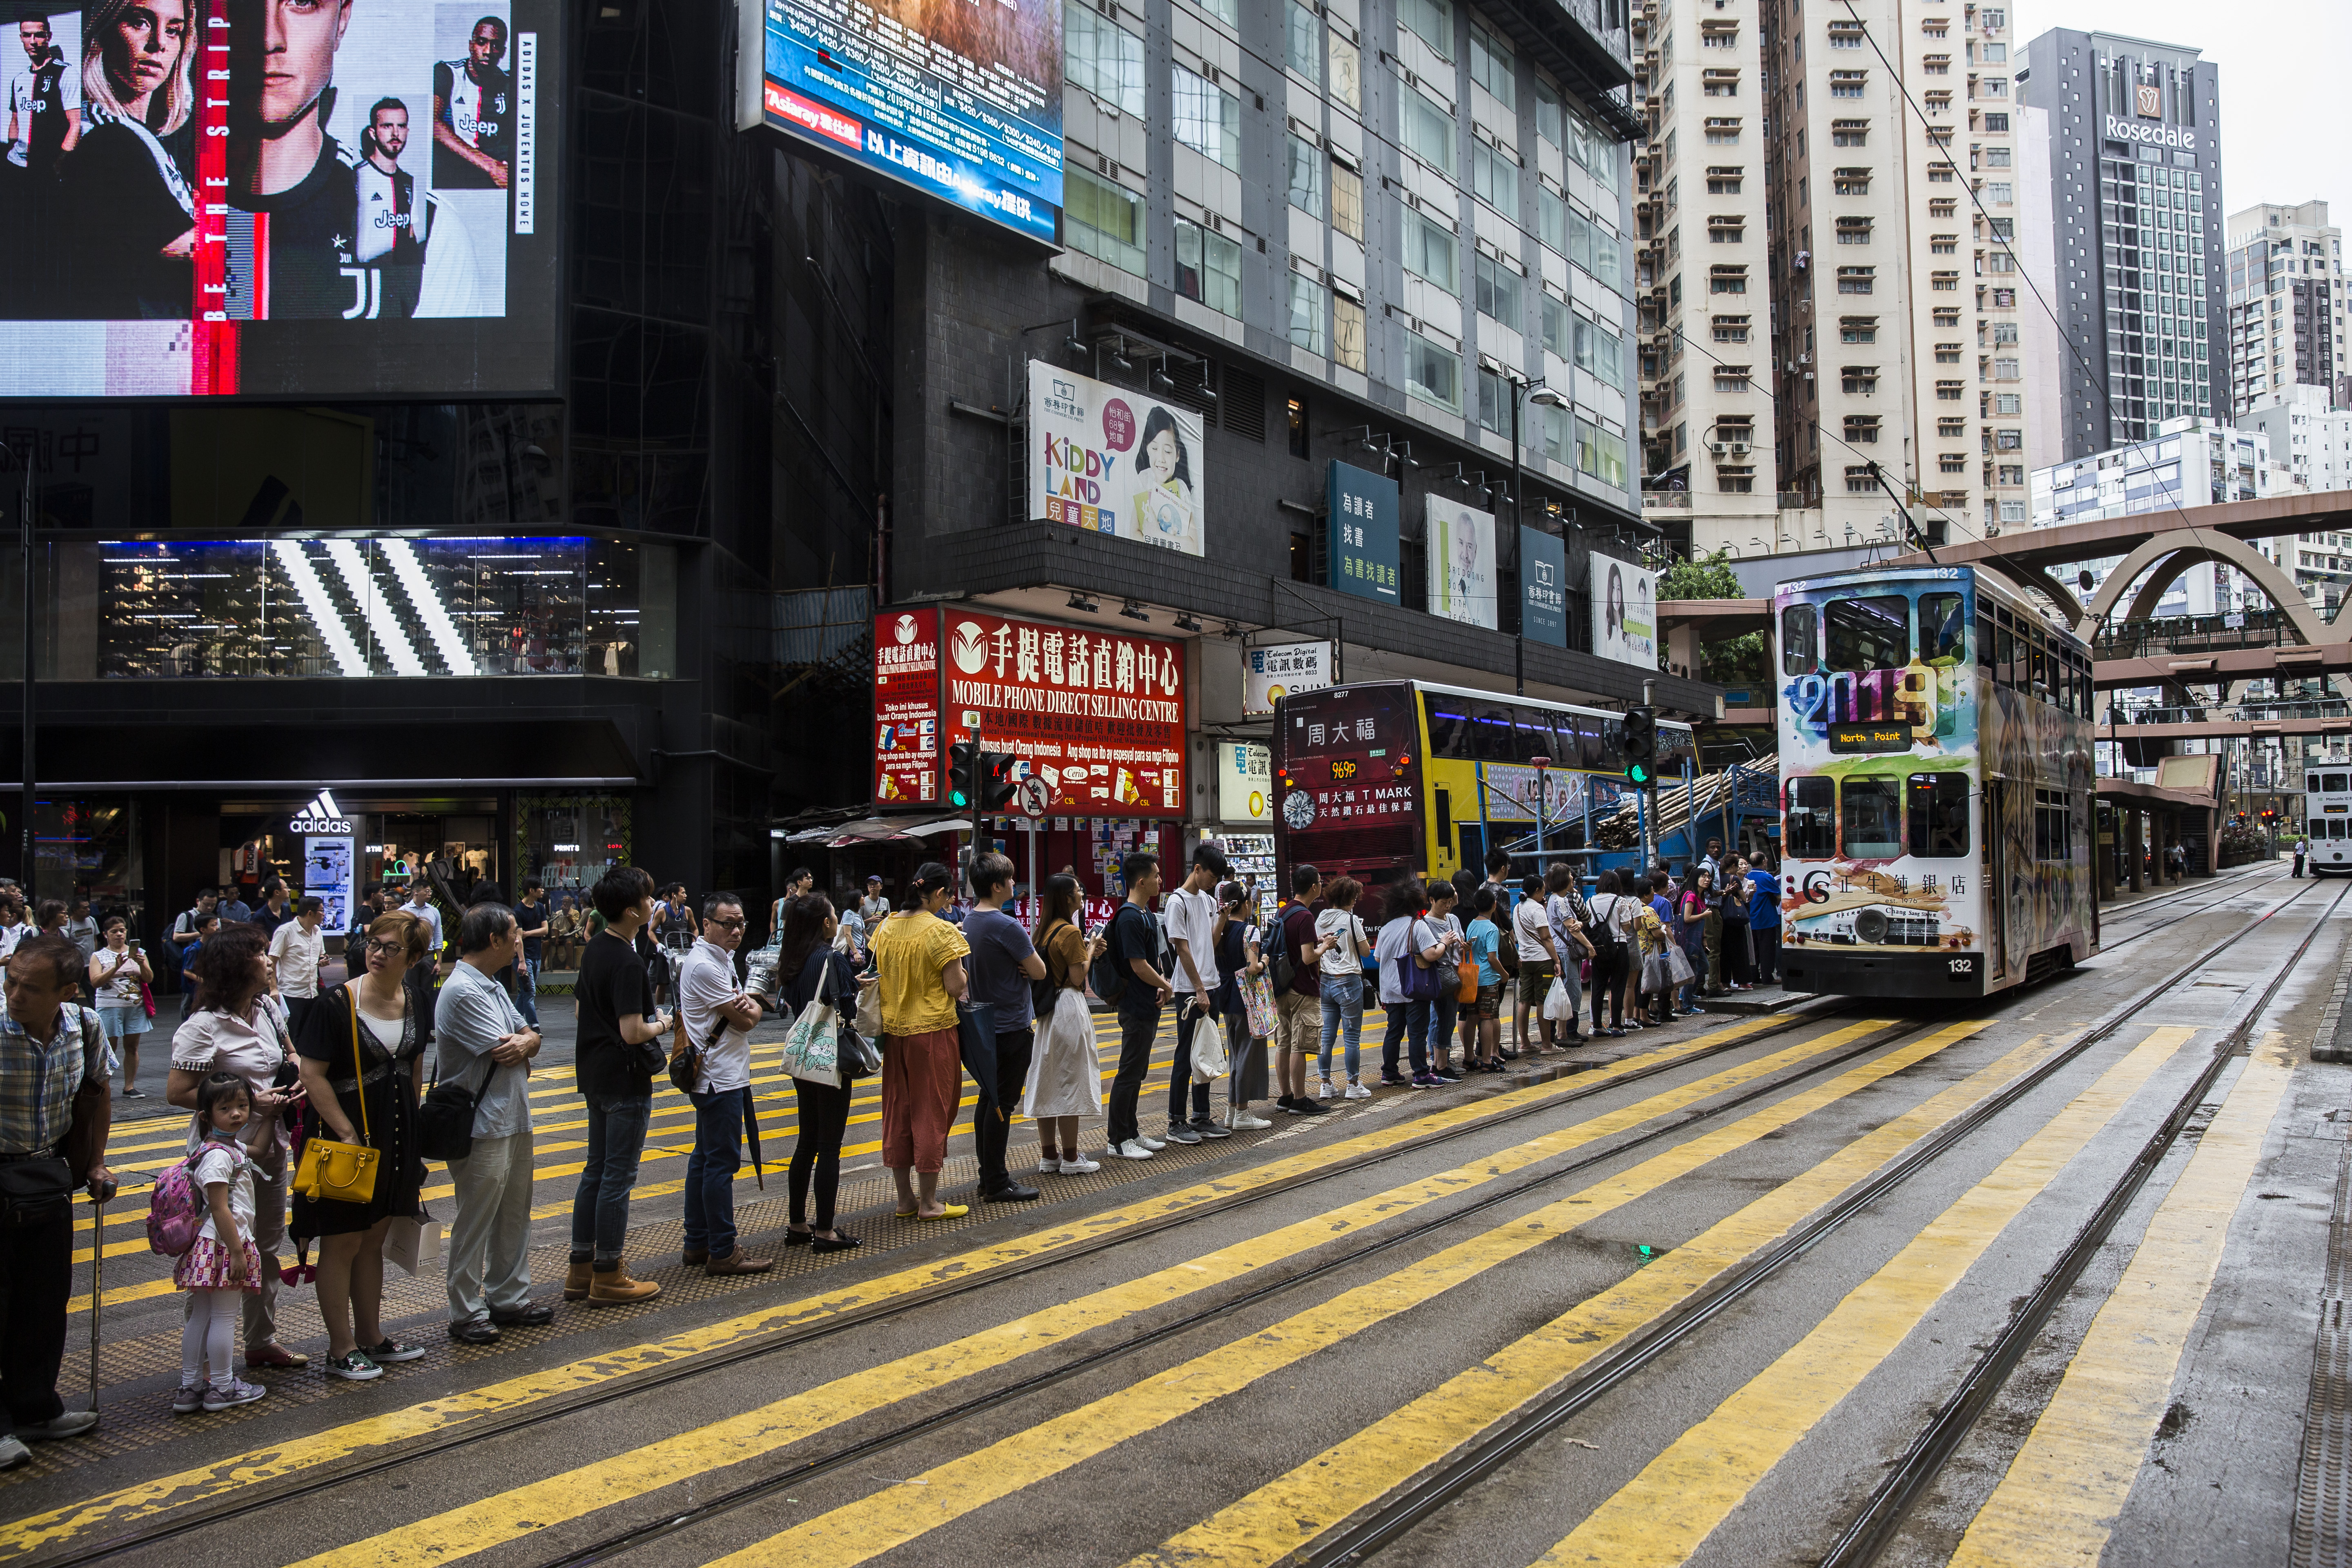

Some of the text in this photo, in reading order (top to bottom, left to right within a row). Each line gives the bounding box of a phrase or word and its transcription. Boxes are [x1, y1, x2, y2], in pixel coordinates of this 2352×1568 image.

[522, 40, 532, 91] ADIDAS
[20, 97, 47, 113] Jeep
[769, 90, 819, 128] Asiaray
[459, 114, 498, 136] Jeep
[2106, 114, 2195, 149] Rosedale
[521, 114, 531, 184] JUVENTUS
[204, 17, 231, 322] BE THE STRIP
[520, 192, 529, 227] HOME
[376, 210, 410, 228] Jeep
[1051, 410, 1074, 420] COMMERCIAL
[1109, 405, 1131, 423] 怡和街
[1109, 421, 1125, 433] 68號
[1109, 432, 1124, 445] 地庫
[1046, 467, 1101, 505] LAND
[1159, 490, 1170, 501] Ladybird
[1343, 492, 1373, 520] 為讀者
[1049, 501, 1112, 532] 兒童天地
[1343, 523, 1363, 548] 找書
[1344, 555, 1395, 586] 為書找讀者
[1448, 563, 1484, 582] BRIDGING
[1933, 568, 1958, 579] 132
[1448, 579, 1470, 594] BOOS
[1786, 581, 1807, 592] 132
[1448, 597, 1466, 608] WITH
[1535, 601, 1553, 611] COMMERCIAL
[1628, 603, 1651, 617] BRIDGING
[1534, 616, 1545, 625] SINCE
[1628, 615, 1642, 627] BOOKS
[1628, 630, 1640, 639] WITH
[878, 642, 935, 664] 手提電話直銷中心
[990, 623, 1178, 695] 手提電話直銷中心
[1266, 647, 1317, 658] Telecom Digital
[1266, 656, 1317, 672] 電訊數碼
[952, 679, 1178, 723] MOBILE PHONE DIRECT SELLING CENTRE
[1800, 666, 1937, 737] 2019
[891, 711, 908, 721] Orang
[909, 709, 936, 718] Indonesia
[984, 710, 1028, 729] 本地/國際
[1107, 720, 1171, 739] 歡迎批發及零售
[1308, 718, 1375, 747] 周大福
[984, 726, 999, 735] Local
[1004, 728, 1039, 738] International
[1041, 731, 1063, 741] Roaming
[1078, 734, 1097, 743] Prepaid
[1841, 732, 1900, 742] North Point
[878, 753, 886, 762] Ang
[887, 752, 898, 761] shop
[918, 750, 937, 760] espesyal
[1001, 738, 1014, 754] buat
[1016, 739, 1033, 759] Orang
[1034, 740, 1061, 757] Indonesia
[1067, 743, 1078, 761] Ang
[1079, 744, 1091, 762] shop
[1092, 748, 1098, 759] na
[1107, 749, 1113, 763] ay
[1114, 747, 1134, 764] espesyal
[1135, 750, 1145, 764] para
[1146, 752, 1151, 761] sa
[1152, 752, 1162, 765] mga
[1163, 748, 1178, 765] Filipino
[1248, 748, 1268, 757] Telecom
[912, 760, 928, 770] Filipino
[1067, 769, 1084, 777] Ceria
[1332, 761, 1356, 779] 969P
[1319, 786, 1412, 804] 周大福 T MARK
[1319, 801, 1412, 817] 天然鑽石最佳保證
[290, 818, 352, 833] adidas
[541, 866, 559, 888] FEEL
[1840, 874, 1966, 895] 正生純銀店
[1886, 907, 1906, 915] Chang
[1949, 959, 1972, 972] 132
